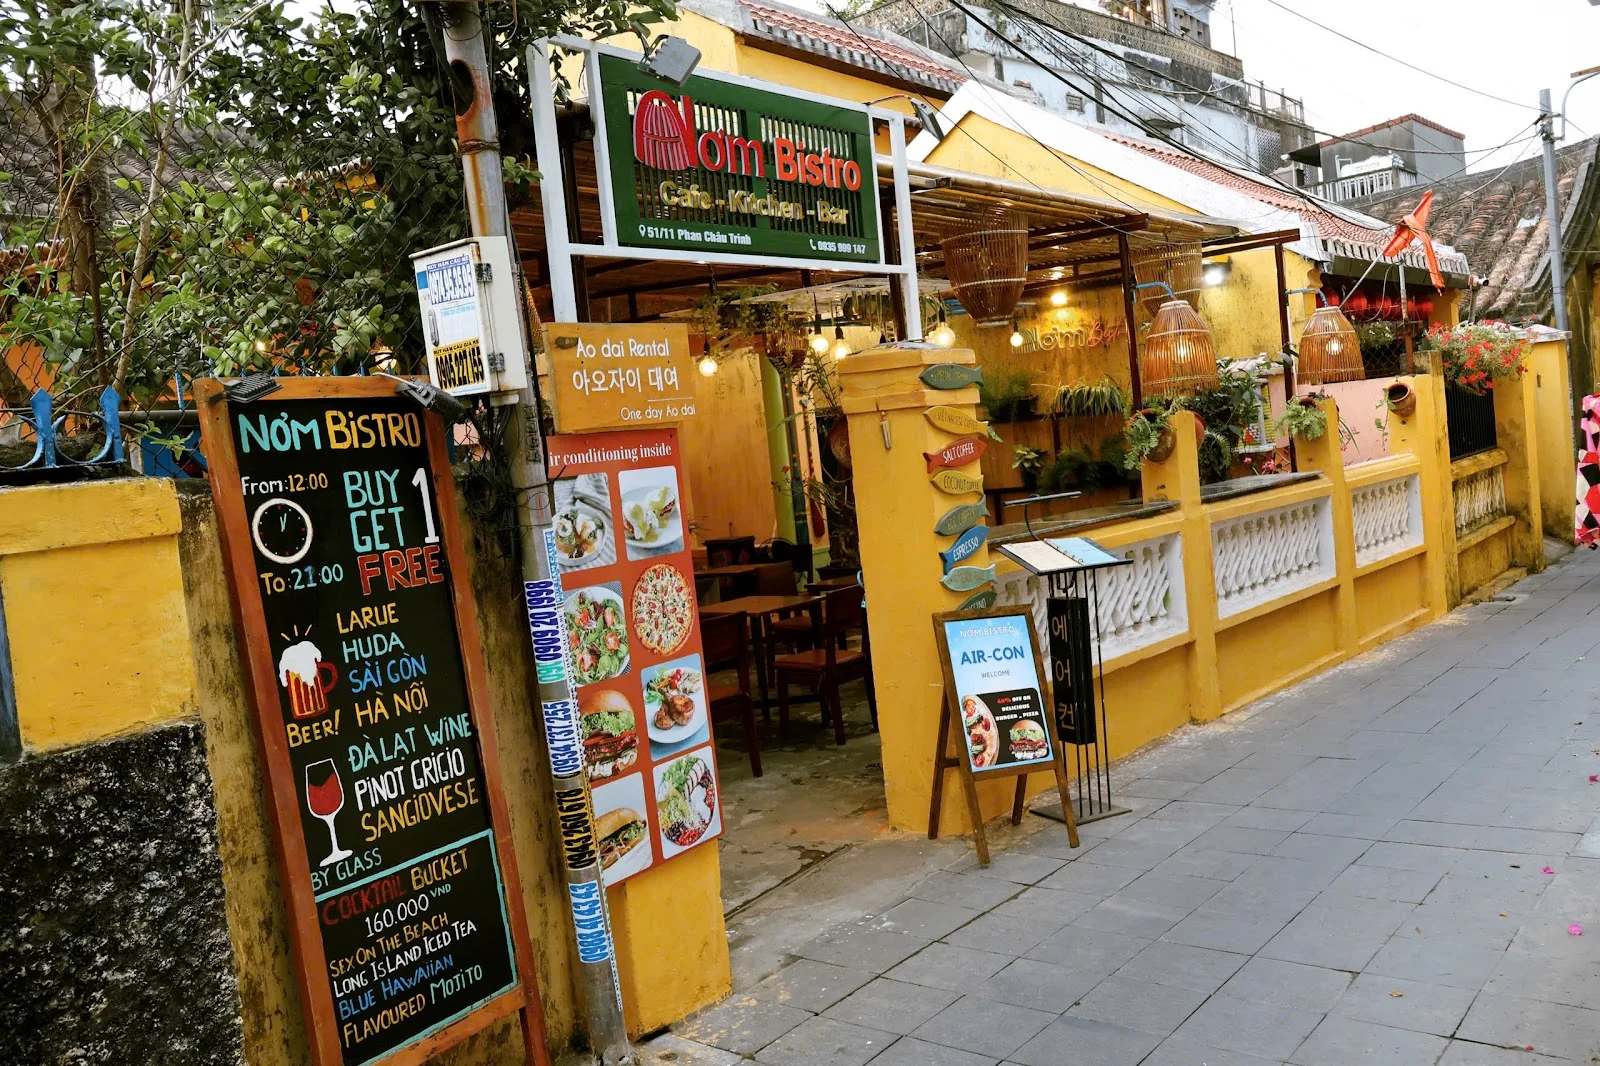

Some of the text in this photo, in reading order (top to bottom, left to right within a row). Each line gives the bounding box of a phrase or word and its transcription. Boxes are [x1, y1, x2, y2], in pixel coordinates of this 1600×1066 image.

[773, 136, 862, 191] Bistro
[660, 180, 712, 210] Cafe
[728, 189, 805, 221] Kitchen
[816, 199, 849, 225] Bar
[647, 226, 675, 240] 51/11
[677, 228, 702, 242] Phan
[728, 232, 752, 245] Trinh
[852, 244, 866, 254] 147
[576, 336, 670, 358] Ao dai Rental
[572, 366, 679, 396] 아오자이 대여
[620, 403, 696, 421] One day Ao dai
[549, 442, 672, 467] ir conditioning inside
[942, 442, 974, 464] SALT COFFEE
[343, 469, 400, 508] BUY
[943, 475, 980, 490] COCONUT COFFEE
[411, 467, 440, 544] 1
[350, 507, 405, 553] GET
[953, 536, 979, 561] ESPRESSO
[357, 545, 445, 596] FREE
[336, 602, 400, 634] LARUE
[525, 580, 563, 662] 0909.20.1998
[983, 625, 1015, 636] BISTRO
[342, 631, 405, 664] HUDA
[960, 645, 1025, 665] AIR-CON
[387, 652, 428, 684] GÒN
[981, 669, 1011, 679] WELCOME
[1052, 614, 1075, 731] 에어컨
[354, 690, 390, 727] HÀ
[995, 713, 1018, 722] BURGER
[1022, 710, 1039, 718] PIZZA
[1001, 703, 1030, 712] DELICIOUS
[286, 709, 341, 748] BEER!
[543, 700, 581, 773] 0934.737.255
[348, 733, 380, 773] ĐÀ
[379, 727, 416, 761] LẠT
[311, 848, 383, 893] BY GLASS
[410, 848, 469, 891] BUCKET
[364, 883, 452, 938] 160.000 VND
[569, 882, 609, 962] 0988.41.43.43
[329, 911, 449, 978] SEX ON THE BEACH
[333, 919, 478, 999] LONG ISLAND ICED TEA
[338, 989, 377, 1021] BLUE
[343, 993, 426, 1048] FLAVOURED
